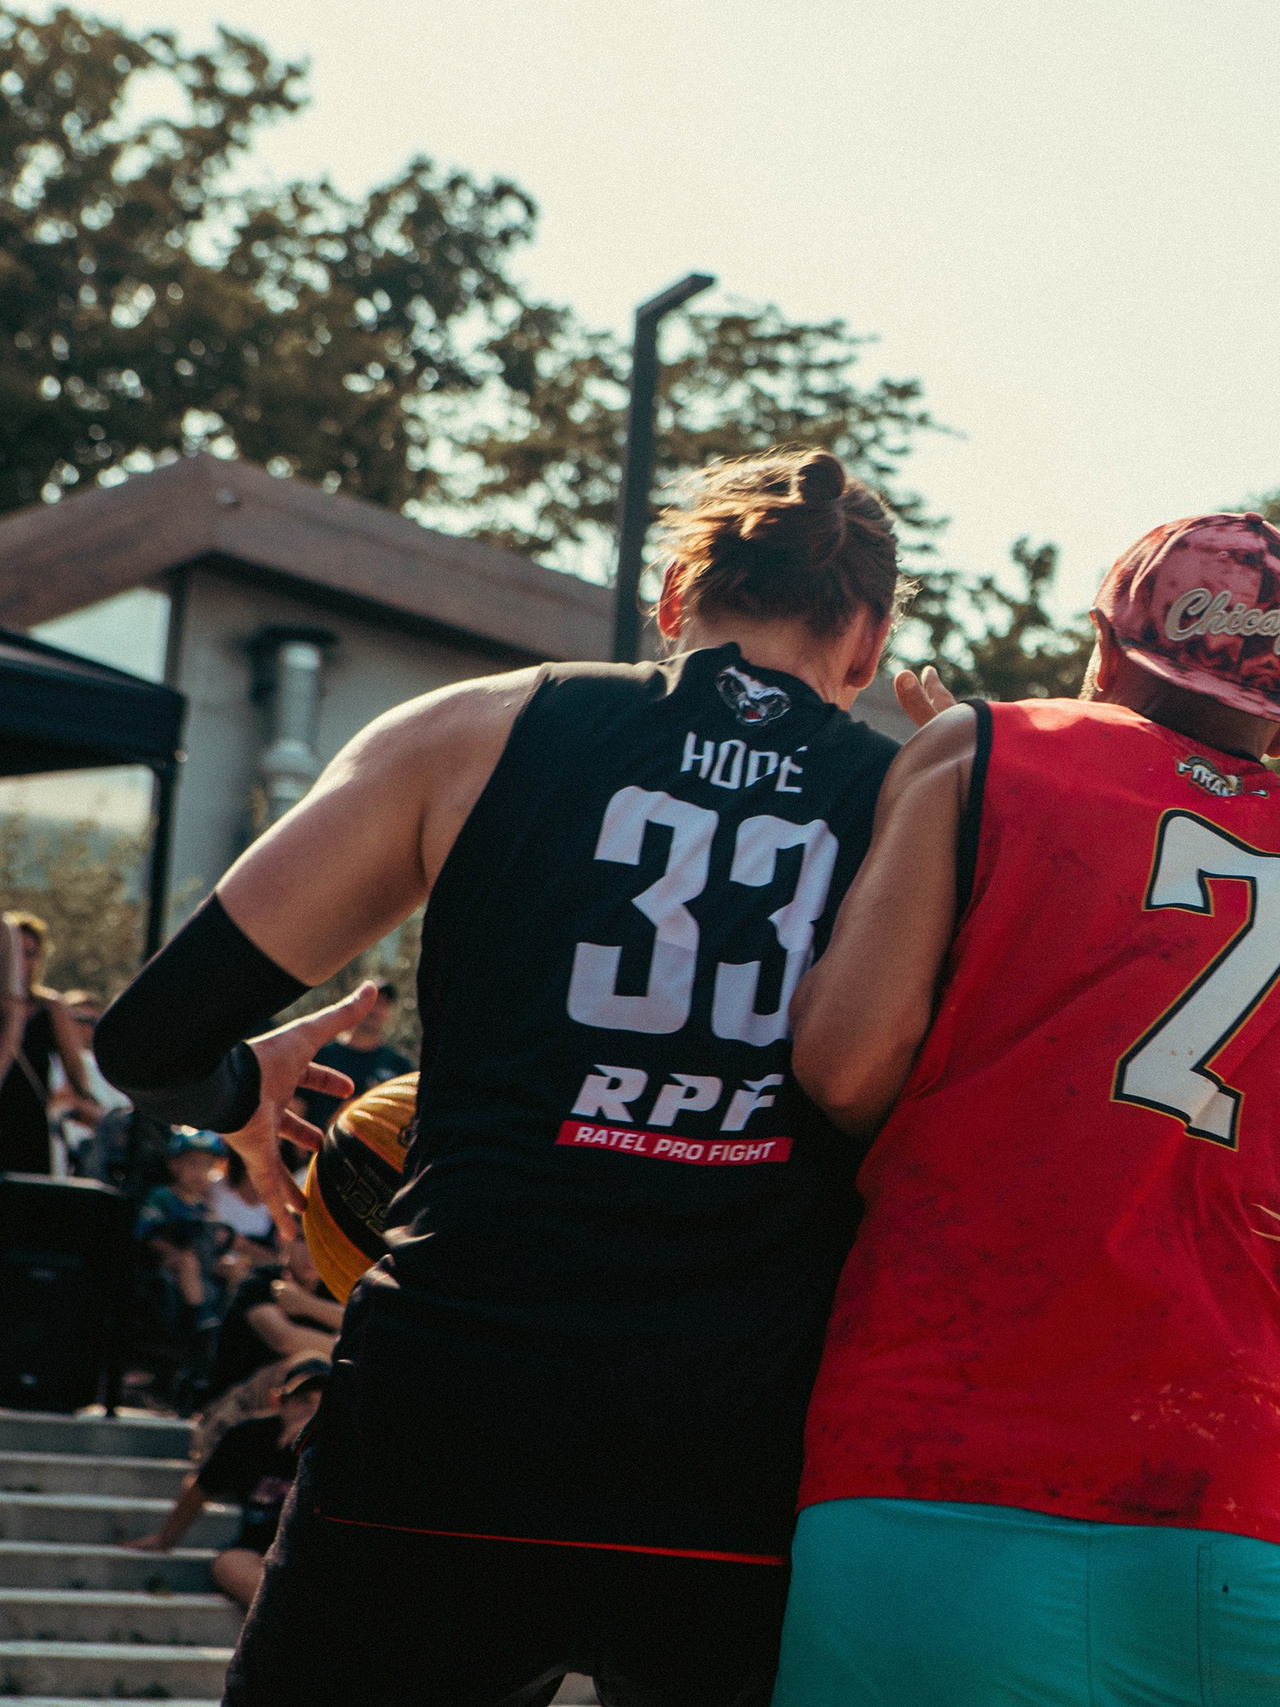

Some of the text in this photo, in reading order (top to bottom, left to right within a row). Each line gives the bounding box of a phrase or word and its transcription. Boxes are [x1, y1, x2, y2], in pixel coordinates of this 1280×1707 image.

[567, 785, 839, 1047] 33
[570, 1064, 784, 1131] RPF
[574, 1126, 776, 1162] RATEL PRO FIGHT
